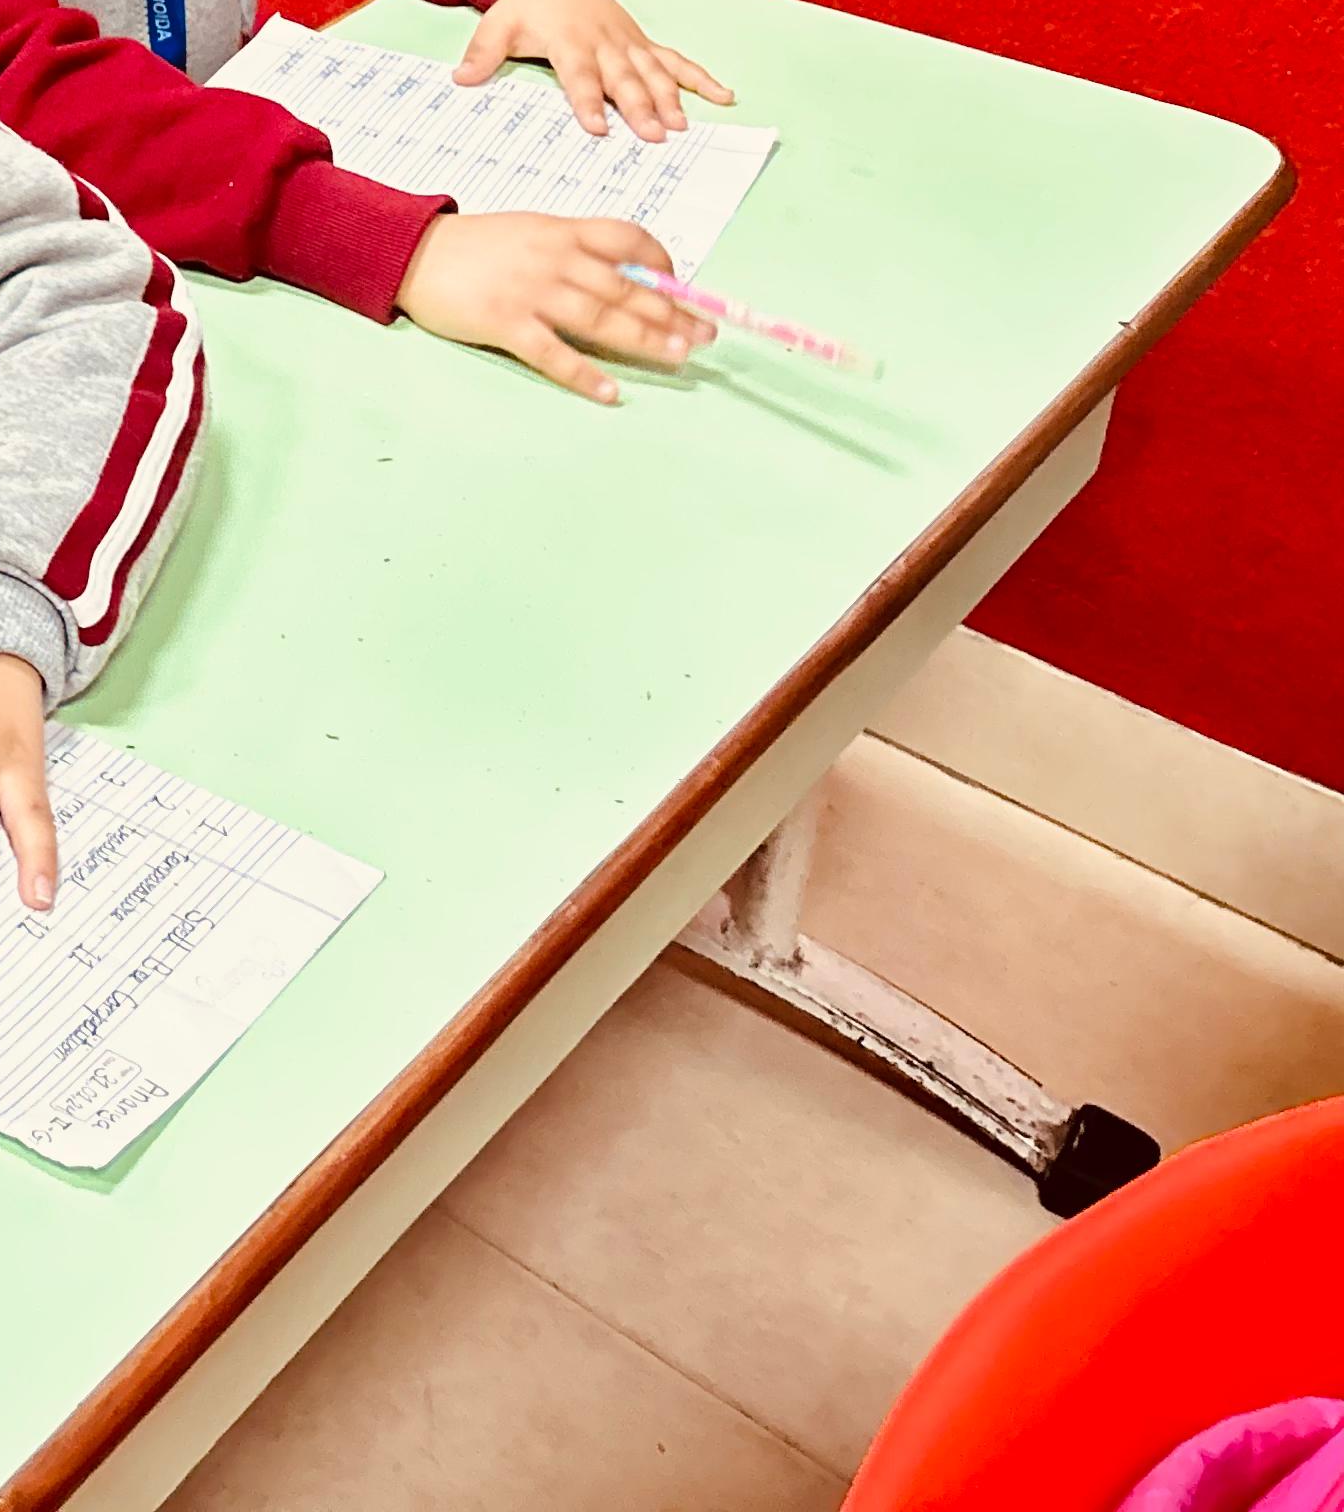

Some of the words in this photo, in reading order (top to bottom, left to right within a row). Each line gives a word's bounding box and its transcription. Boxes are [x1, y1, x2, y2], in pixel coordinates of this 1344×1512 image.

[61, 822, 146, 892] traditional
[15, 913, 49, 939] 12
[158, 910, 215, 955] Spell
[65, 941, 102, 970] 11
[126, 954, 174, 983] Bee
[91, 1078, 169, 1130] Ananya
